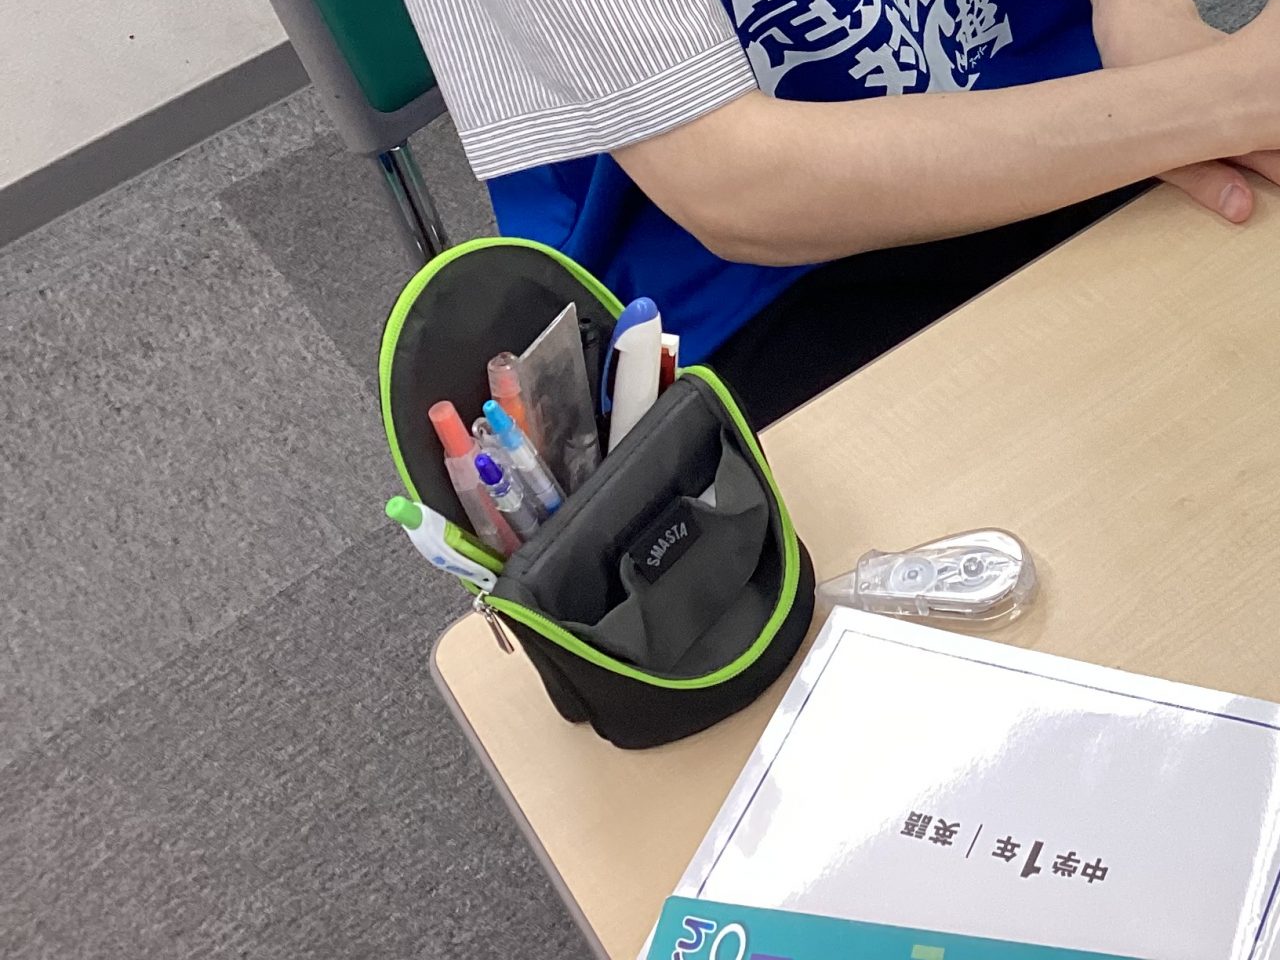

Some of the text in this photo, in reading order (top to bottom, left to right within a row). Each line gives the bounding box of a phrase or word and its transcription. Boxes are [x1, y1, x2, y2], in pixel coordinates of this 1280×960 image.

[647, 522, 688, 566] SMASTA
[900, 811, 1109, 883] 中学1年 英語
